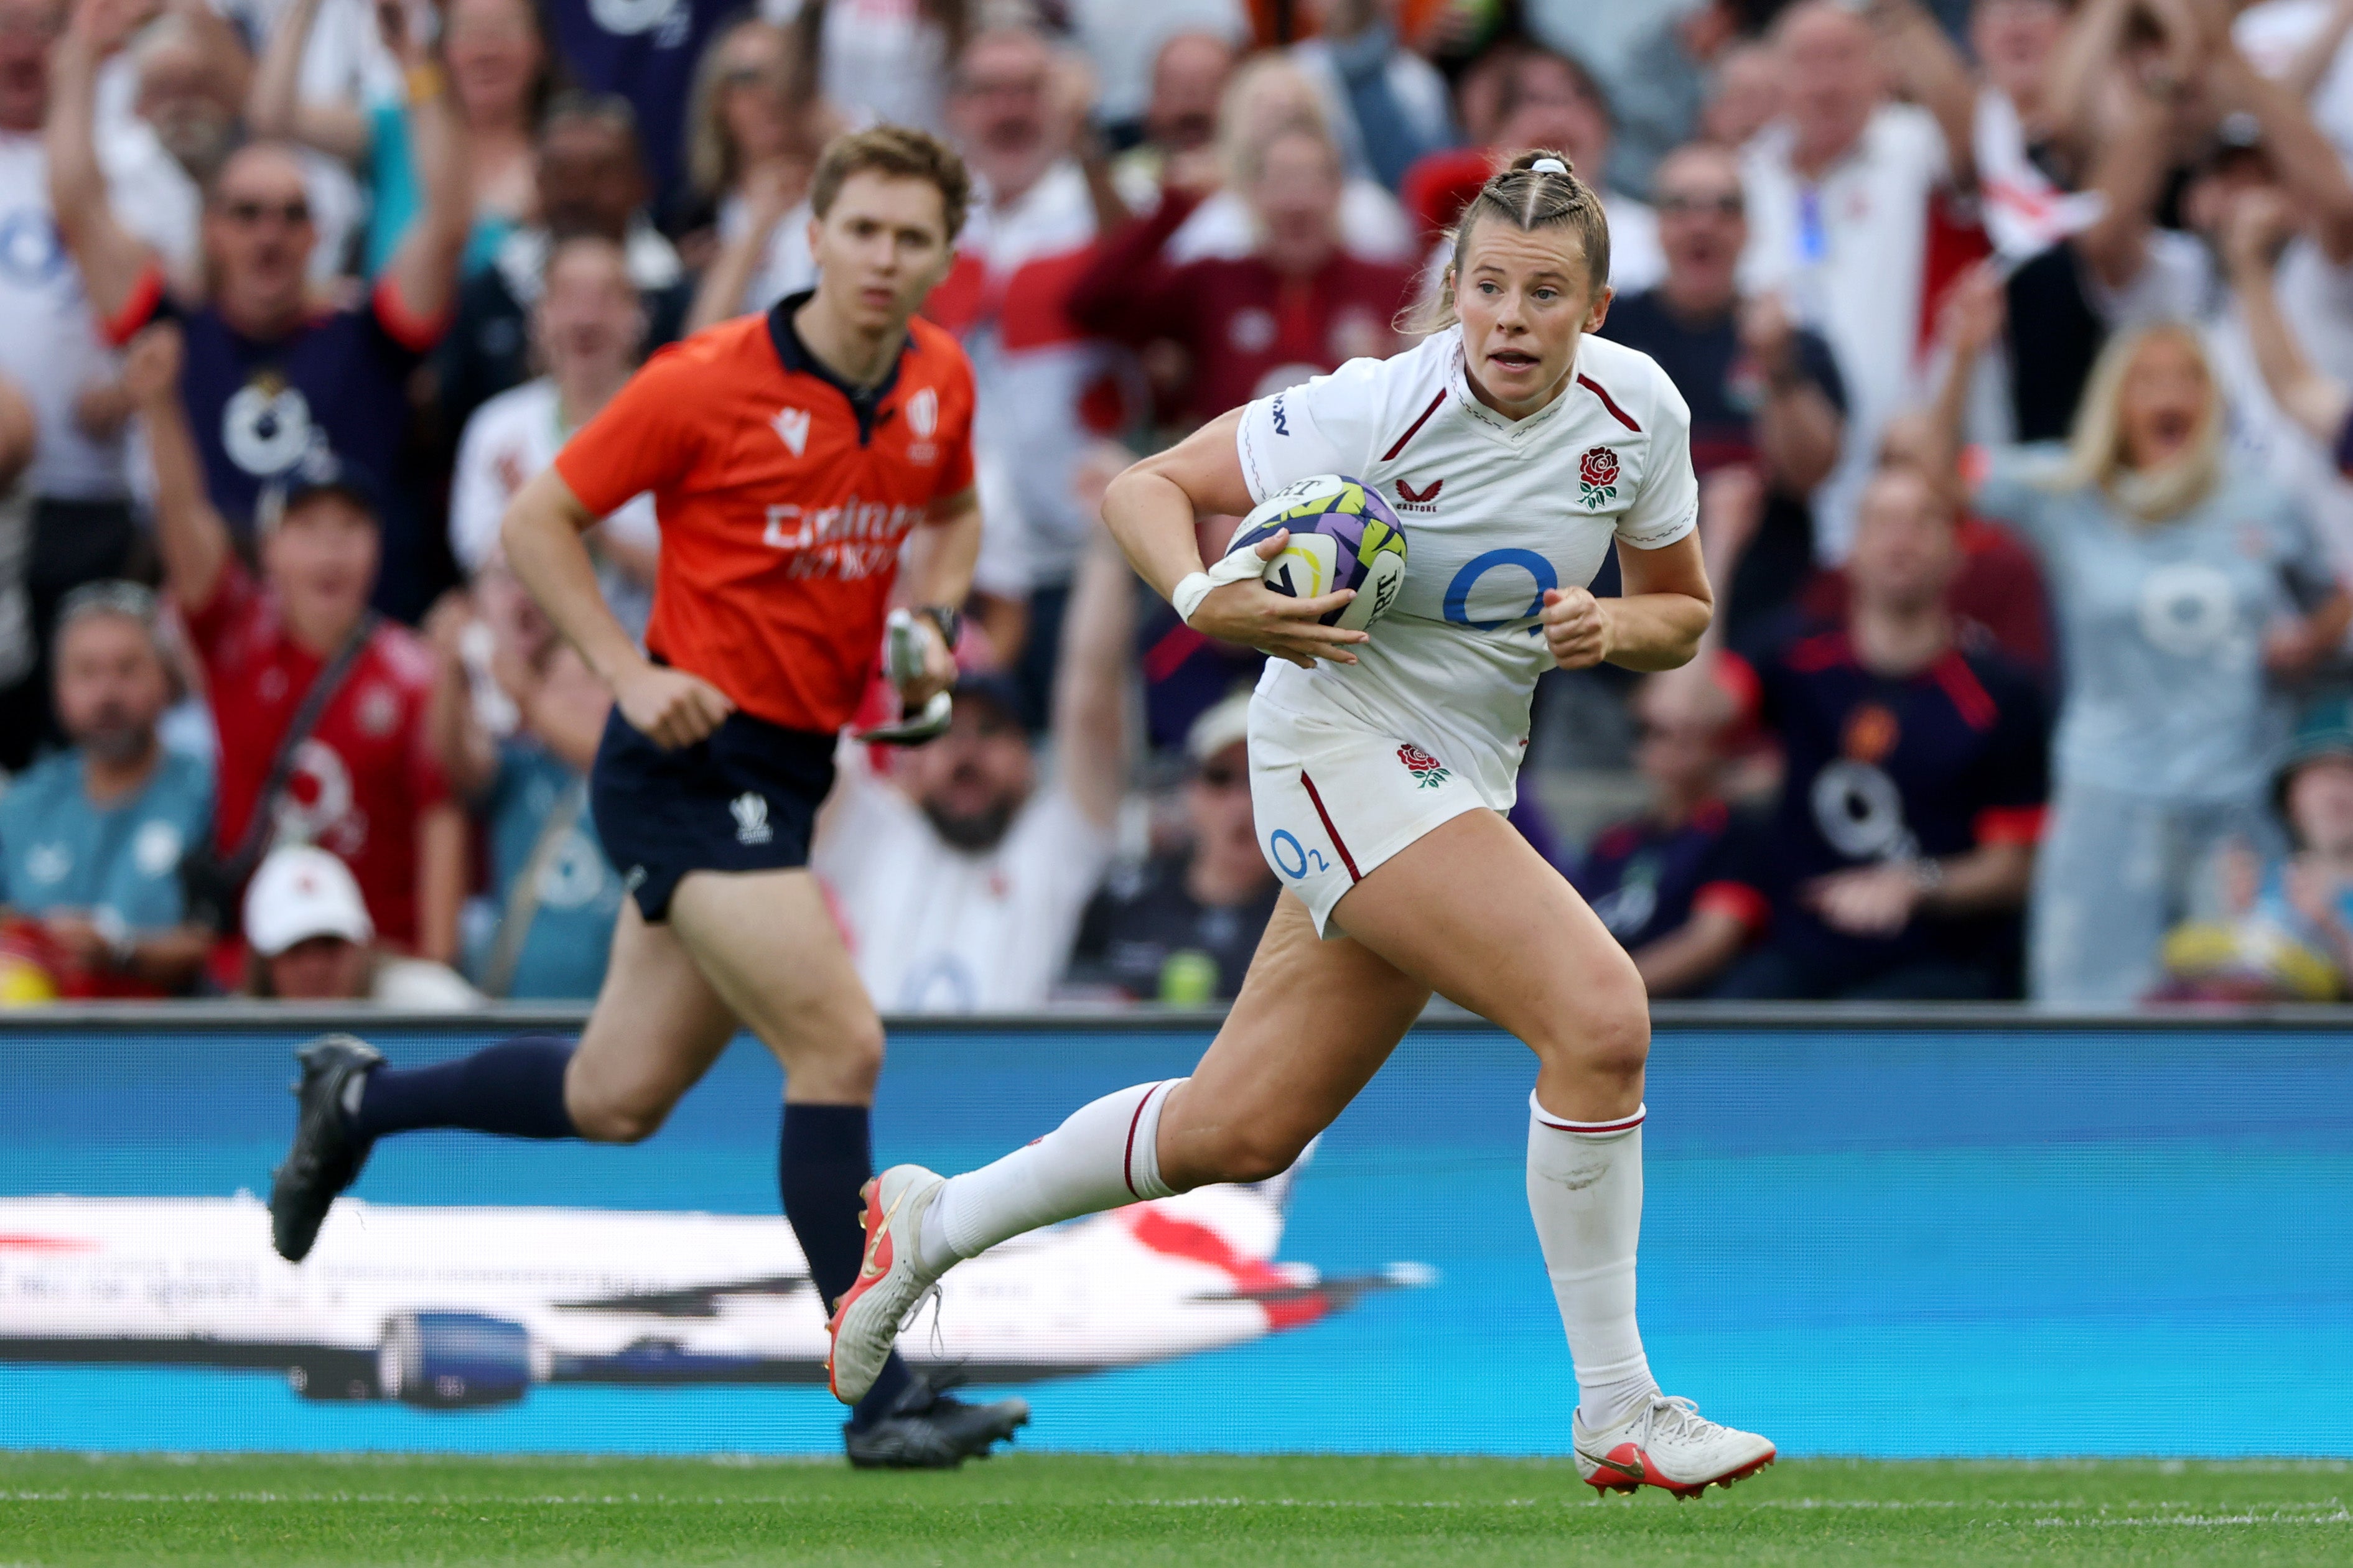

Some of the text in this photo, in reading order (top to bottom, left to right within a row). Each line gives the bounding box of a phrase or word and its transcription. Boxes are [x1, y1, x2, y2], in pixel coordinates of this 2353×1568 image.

[1396, 503, 1437, 512] CASTORE
[1442, 548, 1558, 638] O
[1270, 828, 1330, 879] O2
